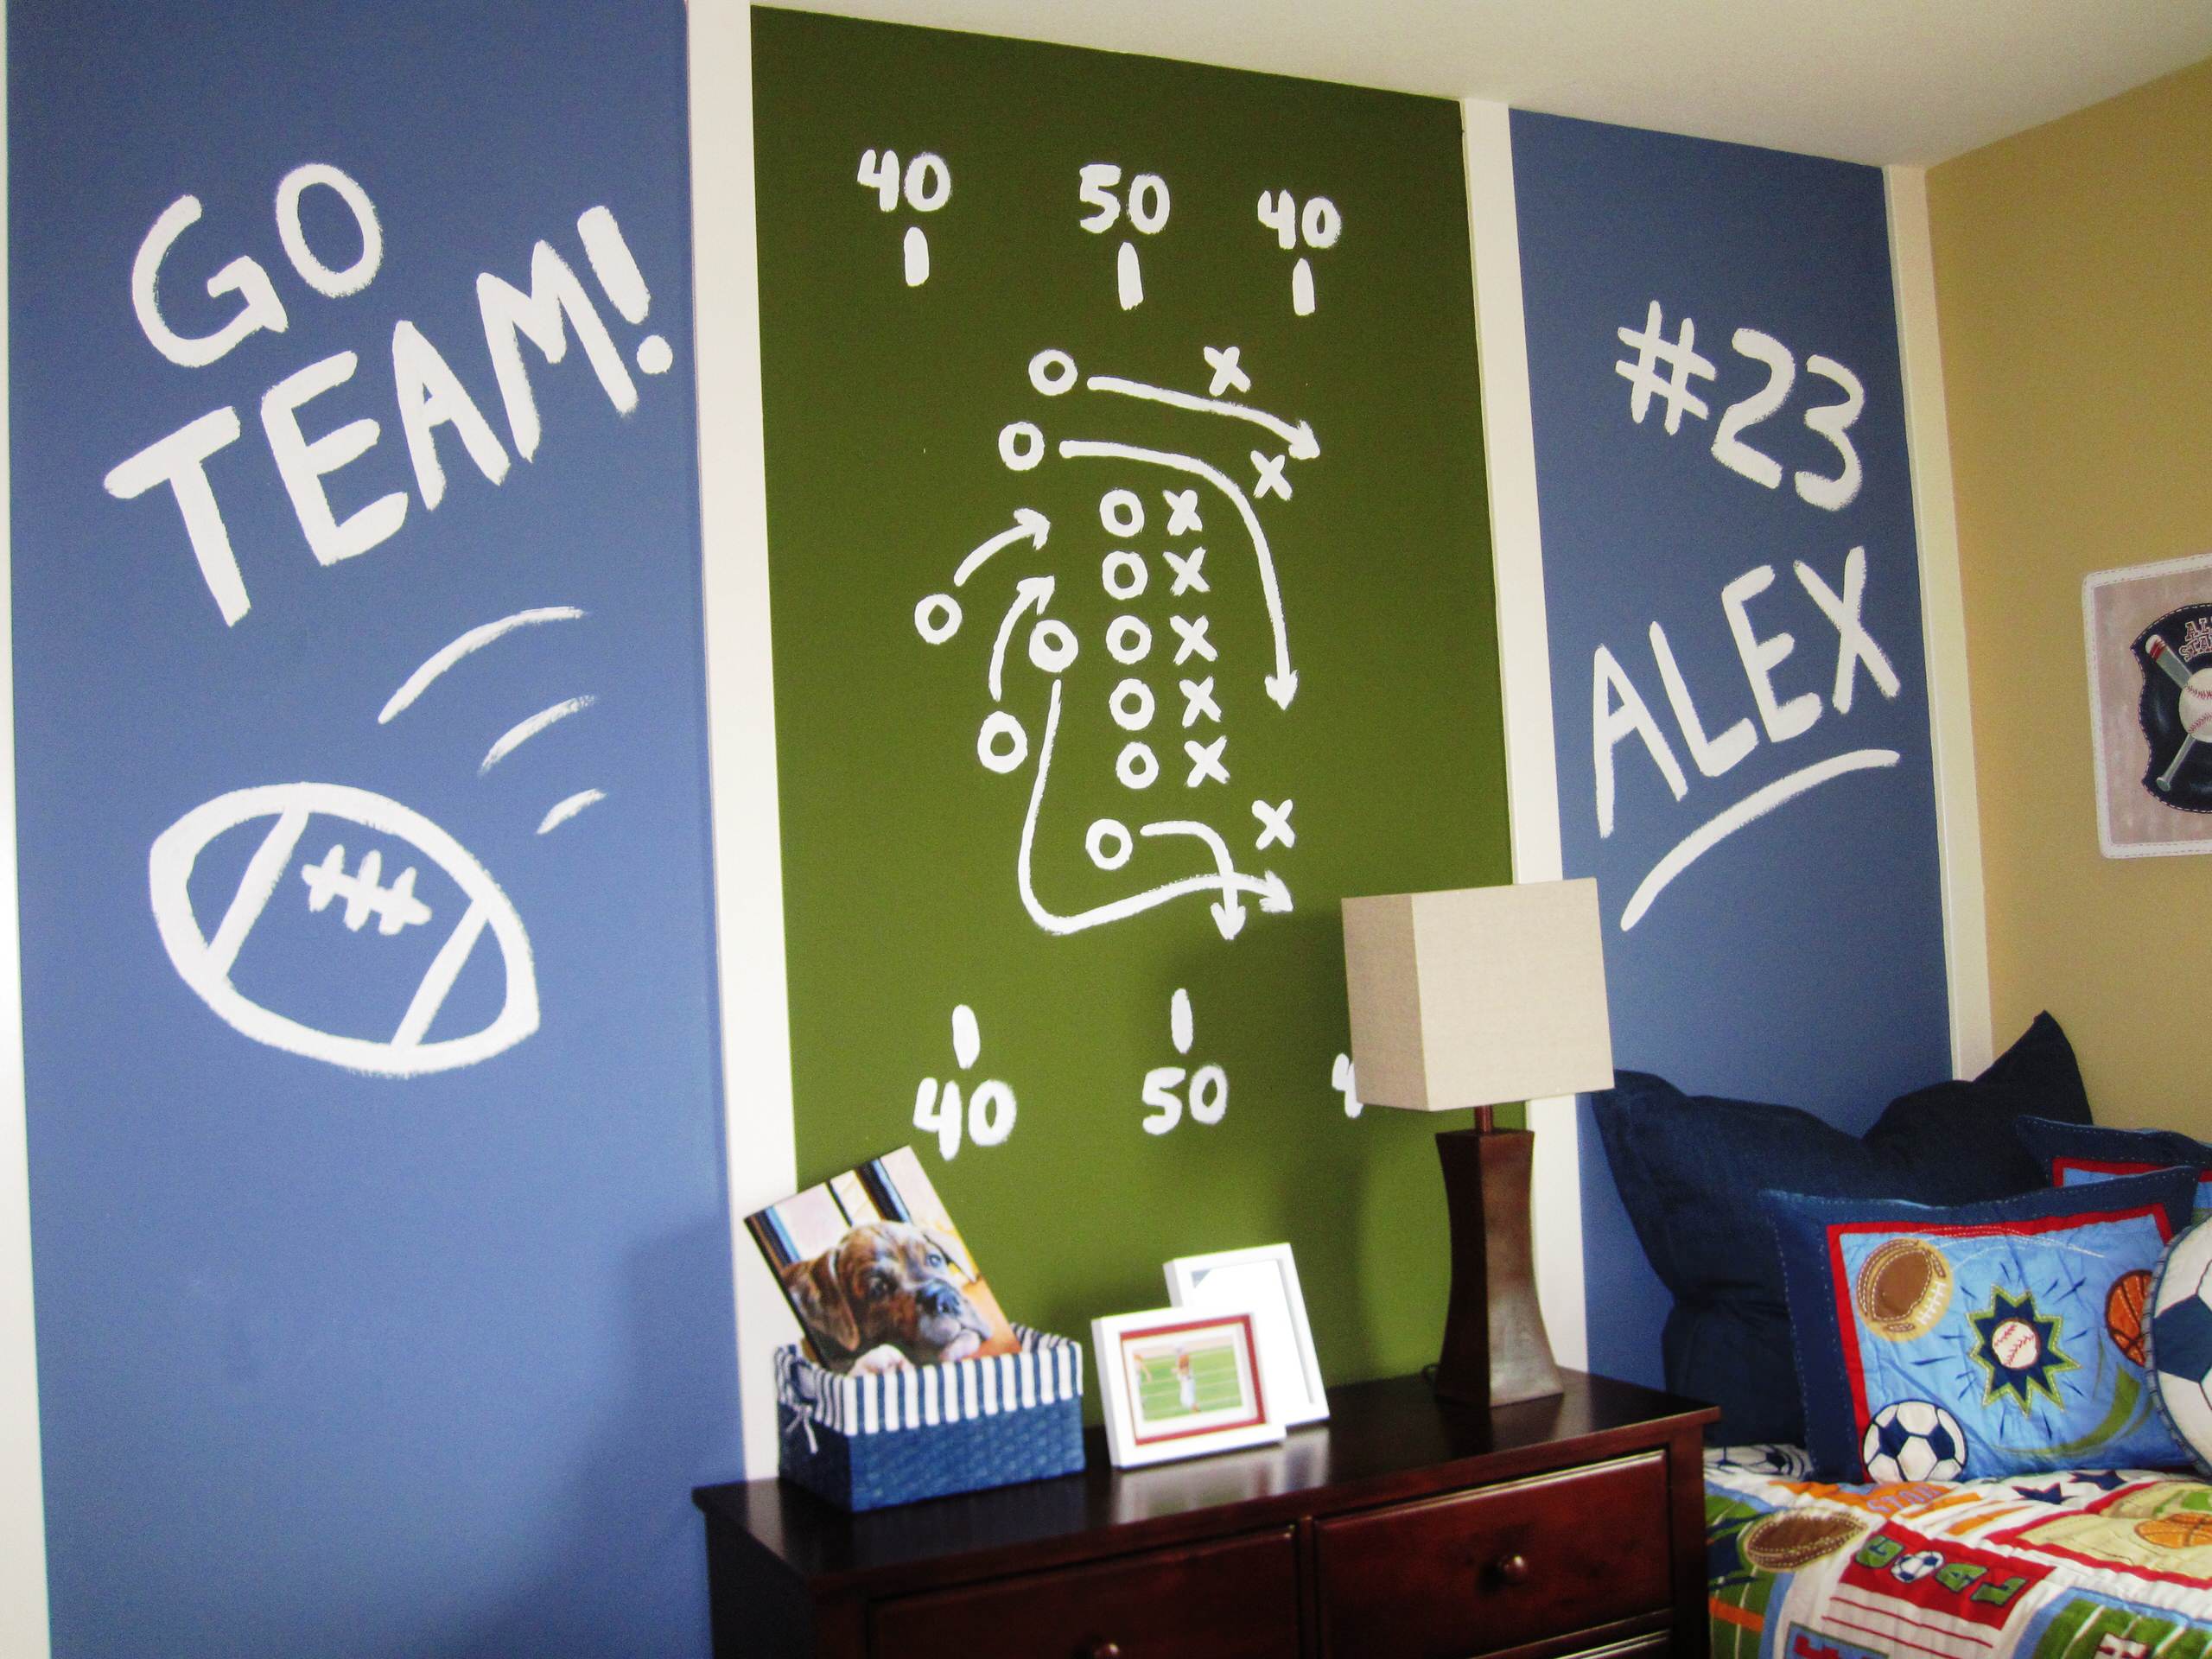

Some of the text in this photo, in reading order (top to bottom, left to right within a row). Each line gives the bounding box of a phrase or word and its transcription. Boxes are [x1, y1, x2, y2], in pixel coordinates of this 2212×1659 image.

[130, 162, 385, 370] GO
[855, 149, 1343, 250] 40 50 40
[102, 204, 674, 629] TEAM!
[1614, 300, 1866, 512] #23
[1592, 544, 1901, 841] ALEX
[2184, 617, 2212, 642] AL
[912, 1052, 1363, 1162] 40 50 4
